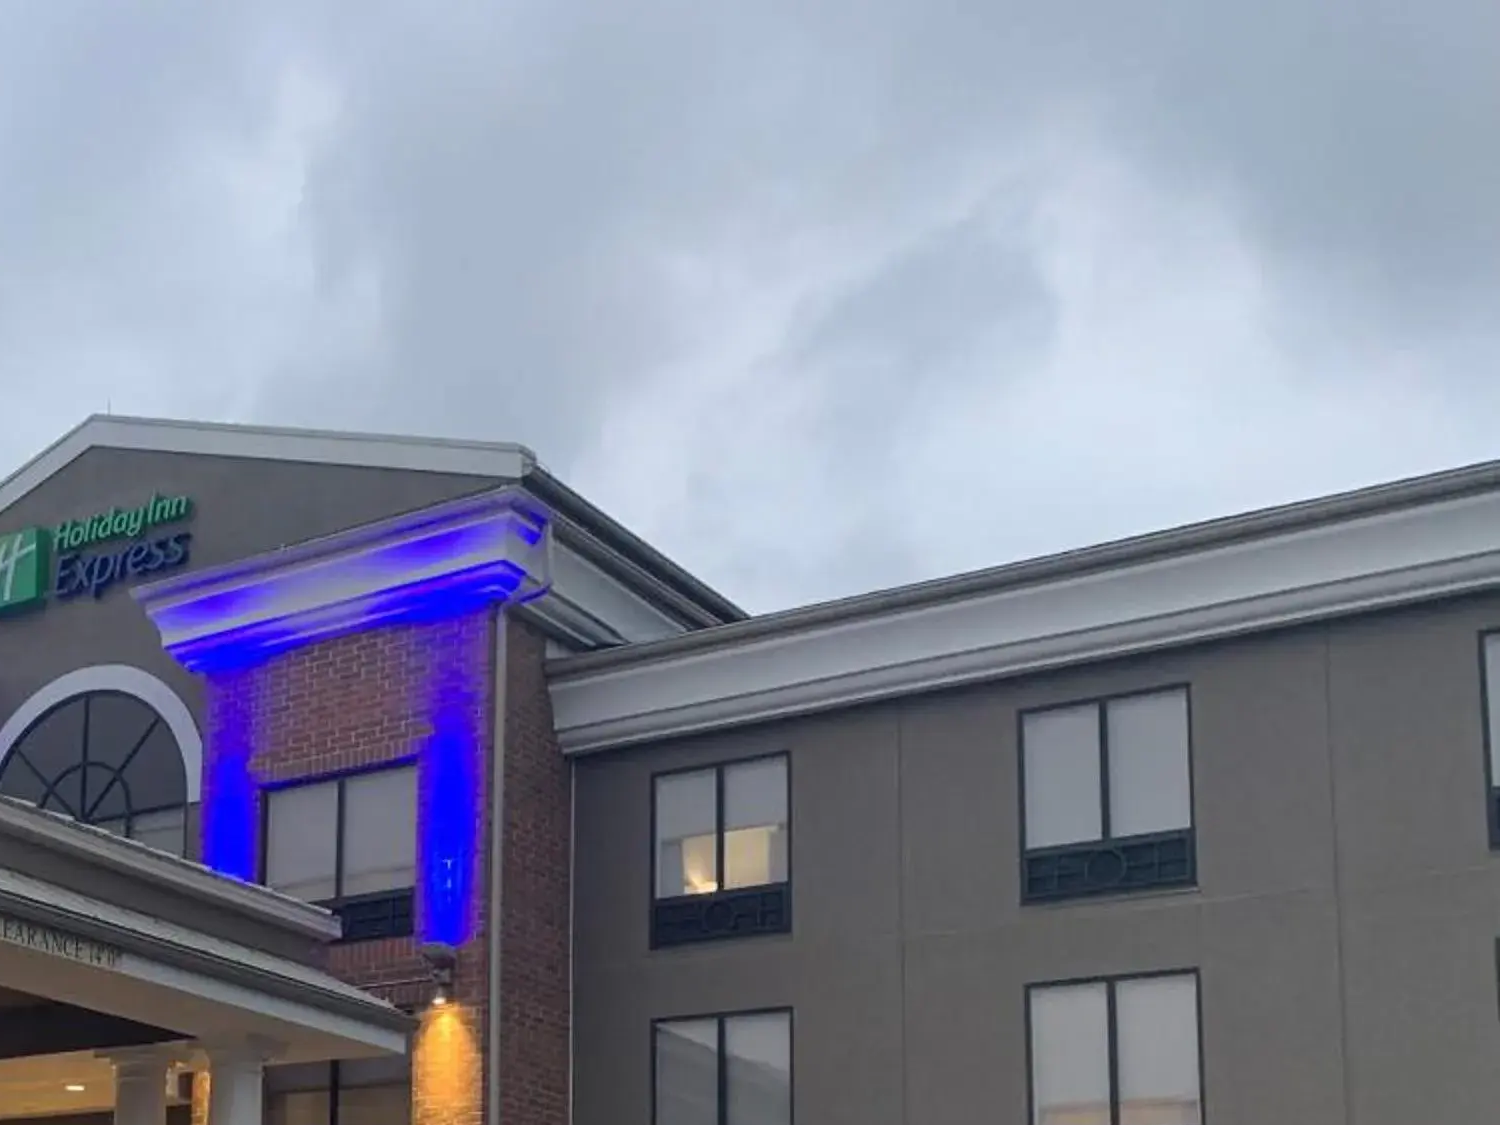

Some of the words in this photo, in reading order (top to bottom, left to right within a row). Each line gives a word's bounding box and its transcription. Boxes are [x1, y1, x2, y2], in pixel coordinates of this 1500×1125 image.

[52, 505, 144, 552] Holiday
[147, 490, 189, 524] Inn
[54, 534, 188, 598] Express
